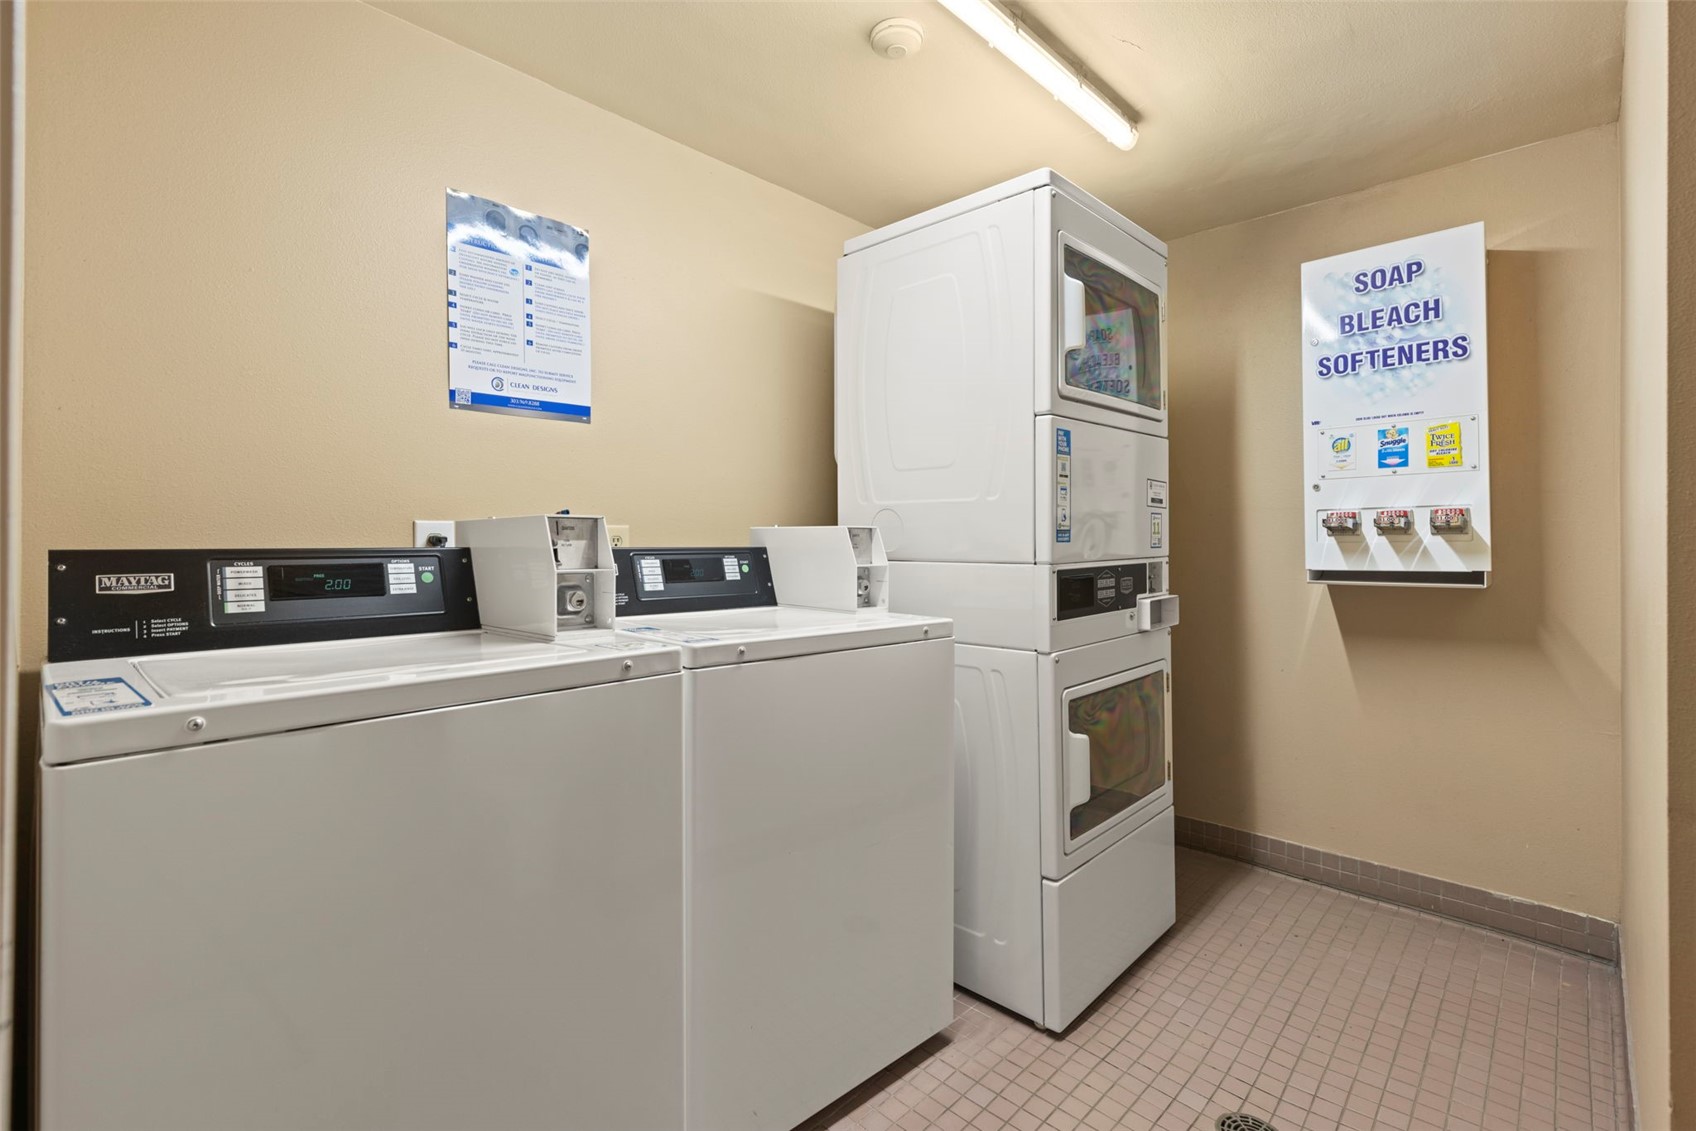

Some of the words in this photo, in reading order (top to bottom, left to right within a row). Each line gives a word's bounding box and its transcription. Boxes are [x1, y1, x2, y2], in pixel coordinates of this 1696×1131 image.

[1354, 261, 1423, 293] SOAP
[1339, 298, 1441, 335] BLEACH
[1318, 335, 1469, 377] SOFTENERS
[510, 382, 530, 390] CLEAN
[532, 385, 558, 393] DESIGNS
[1334, 438, 1349, 452] all
[1380, 438, 1406, 447] Snuggle
[100, 575, 170, 587] MAYTAG
[325, 579, 351, 590] 2.00
